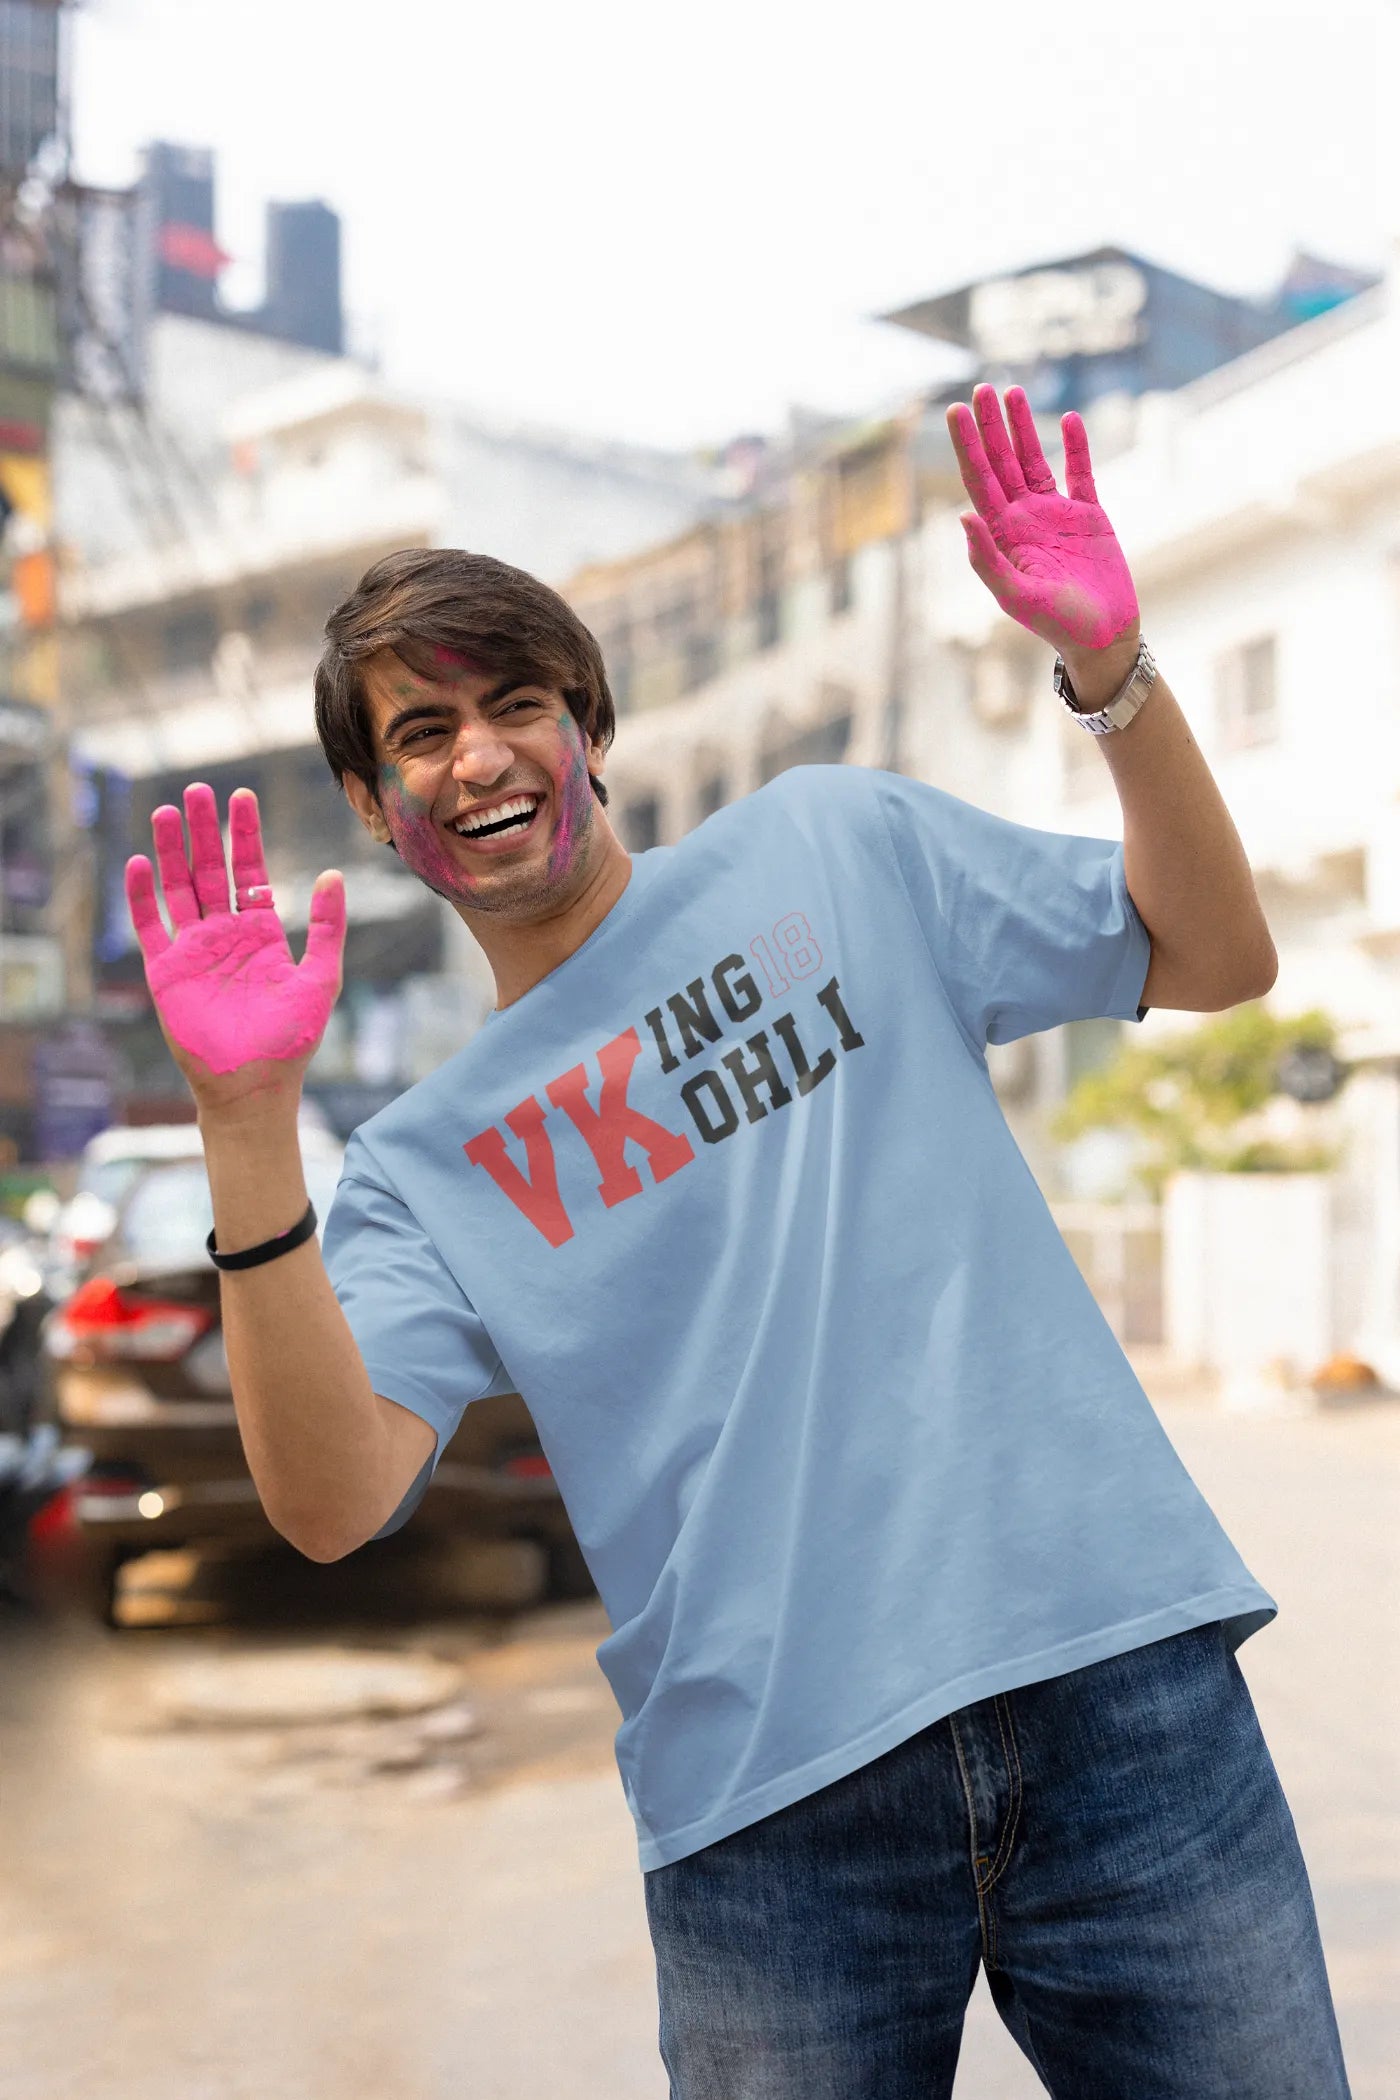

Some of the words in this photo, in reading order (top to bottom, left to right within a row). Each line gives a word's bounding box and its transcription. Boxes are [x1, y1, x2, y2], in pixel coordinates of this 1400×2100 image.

[644, 953, 763, 1074] ING
[749, 912, 823, 999] 18
[680, 975, 866, 1145] OHLI
[462, 1025, 696, 1249] VK
